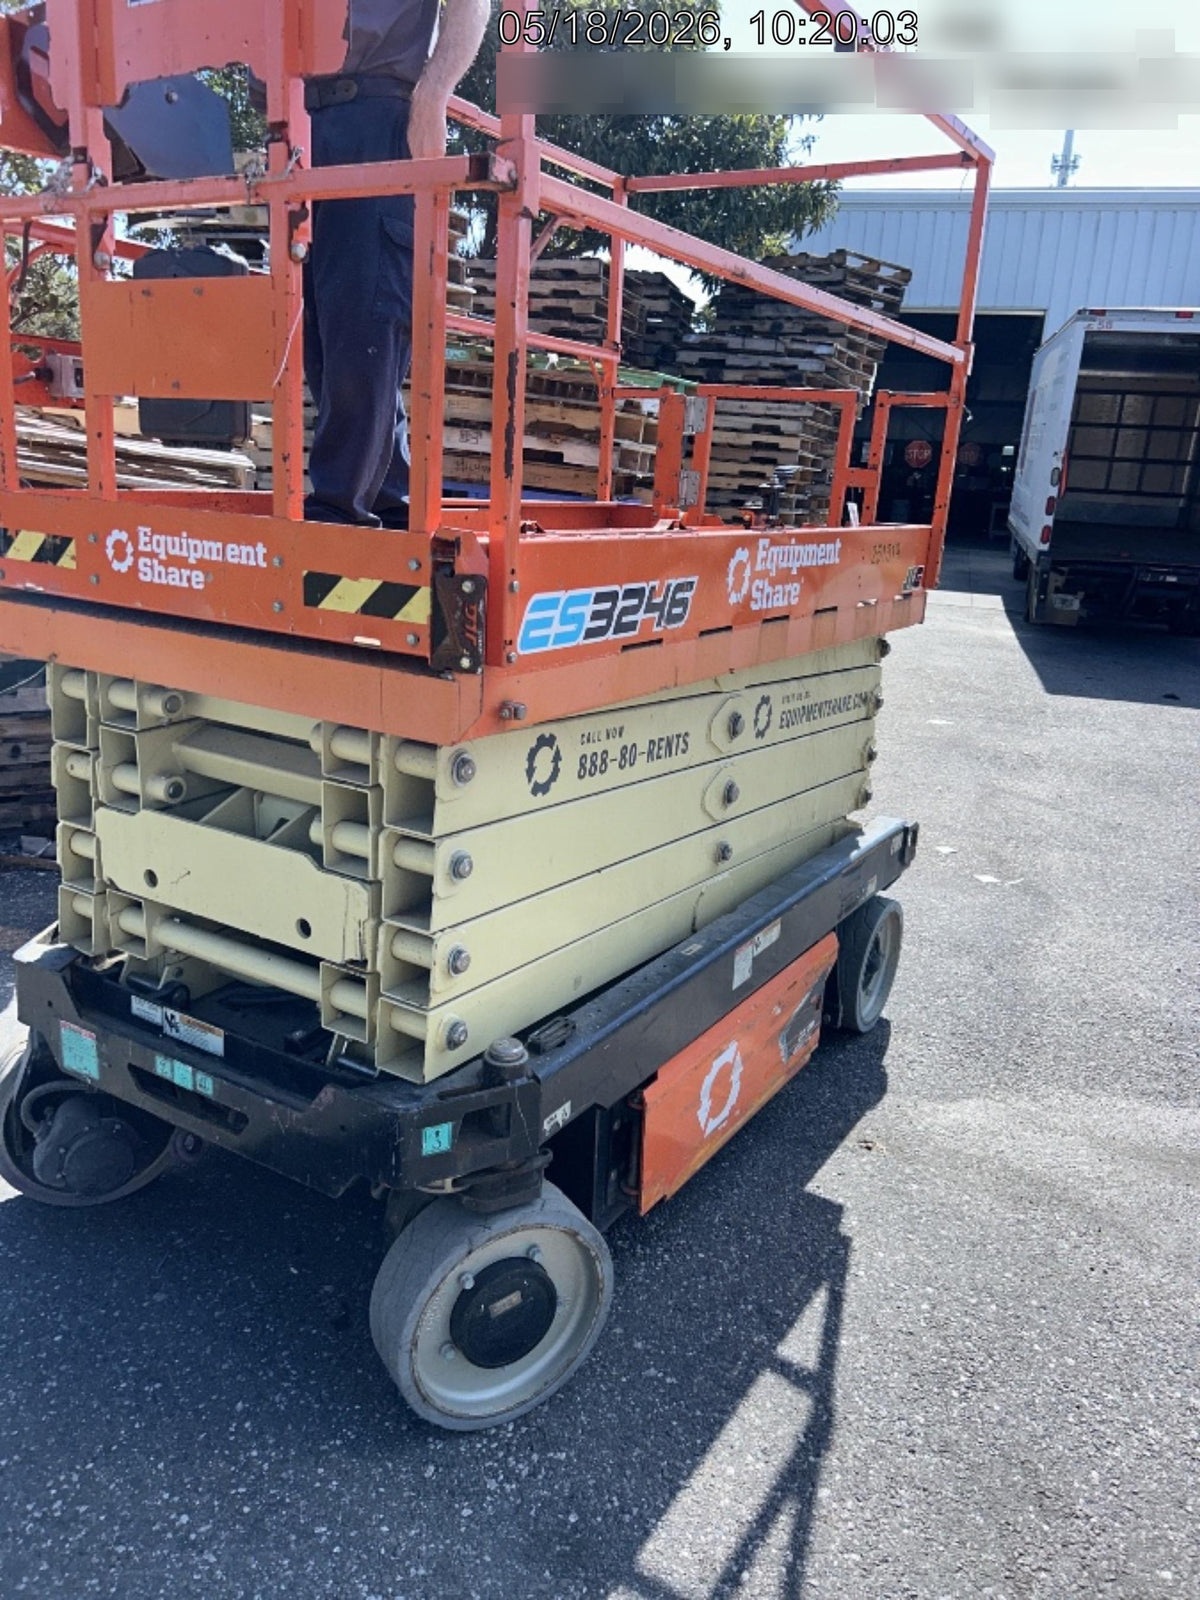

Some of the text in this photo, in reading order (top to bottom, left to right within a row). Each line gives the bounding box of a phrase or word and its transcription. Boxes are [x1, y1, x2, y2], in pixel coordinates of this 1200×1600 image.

[908, 449, 931, 458] STOP
[137, 525, 268, 568] Equipment
[755, 537, 842, 577] Equipment
[137, 556, 206, 590] Share
[749, 577, 800, 611] Share
[517, 577, 698, 655] ES3246
[580, 725, 625, 746] CALL NOW
[577, 731, 690, 780] 888-80-RENTS
